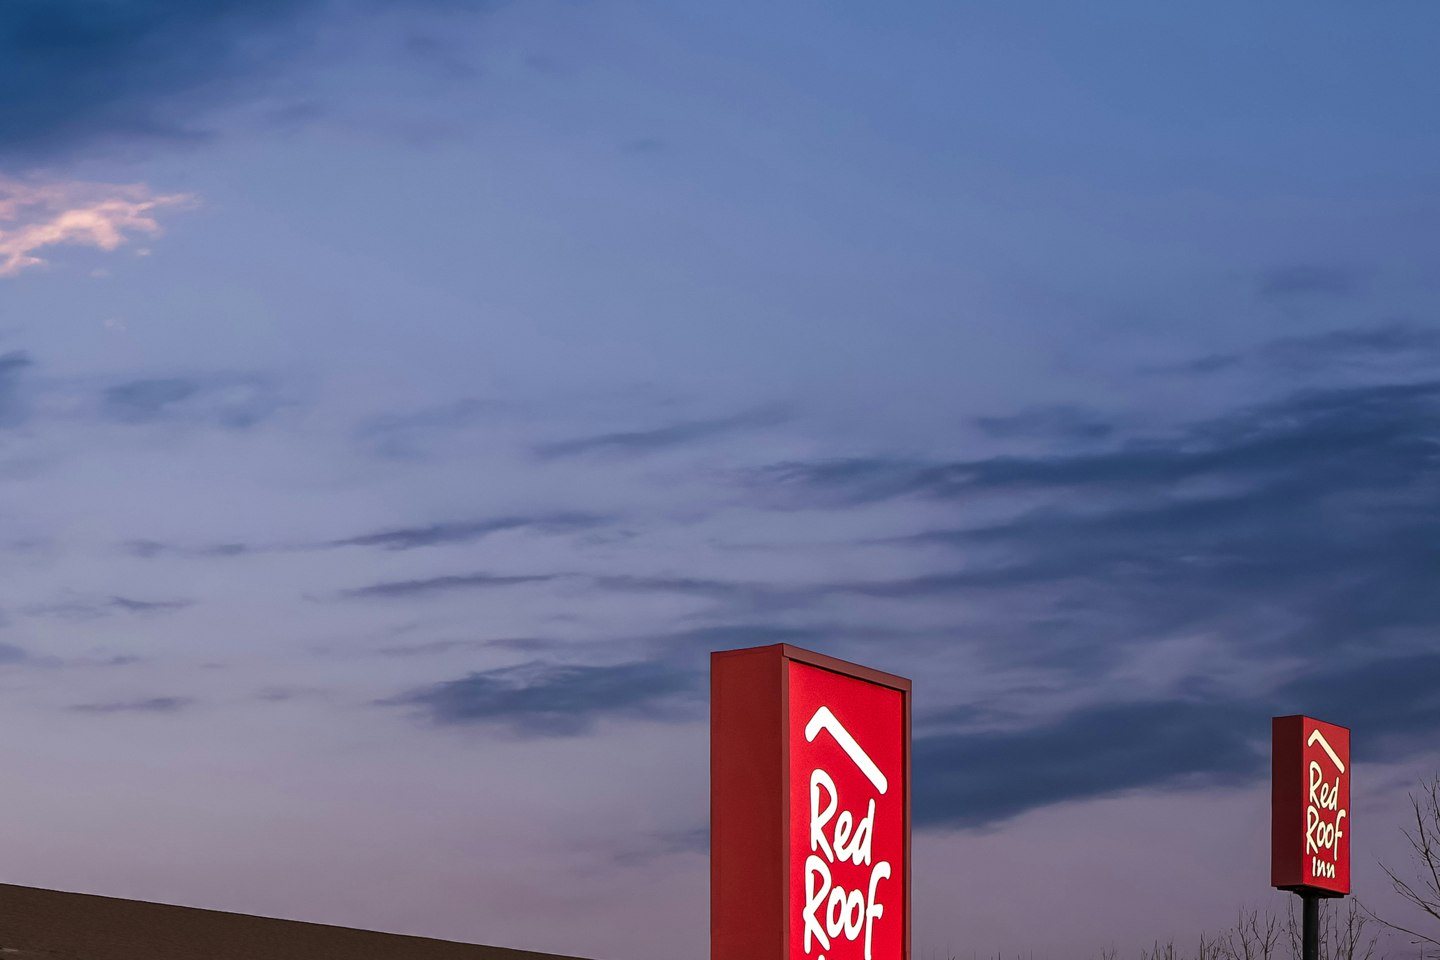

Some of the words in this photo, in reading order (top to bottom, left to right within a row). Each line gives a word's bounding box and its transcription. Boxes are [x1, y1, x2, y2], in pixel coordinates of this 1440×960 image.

[1309, 760, 1340, 812] Red
[809, 767, 876, 867] Red
[1305, 805, 1347, 862] Roof
